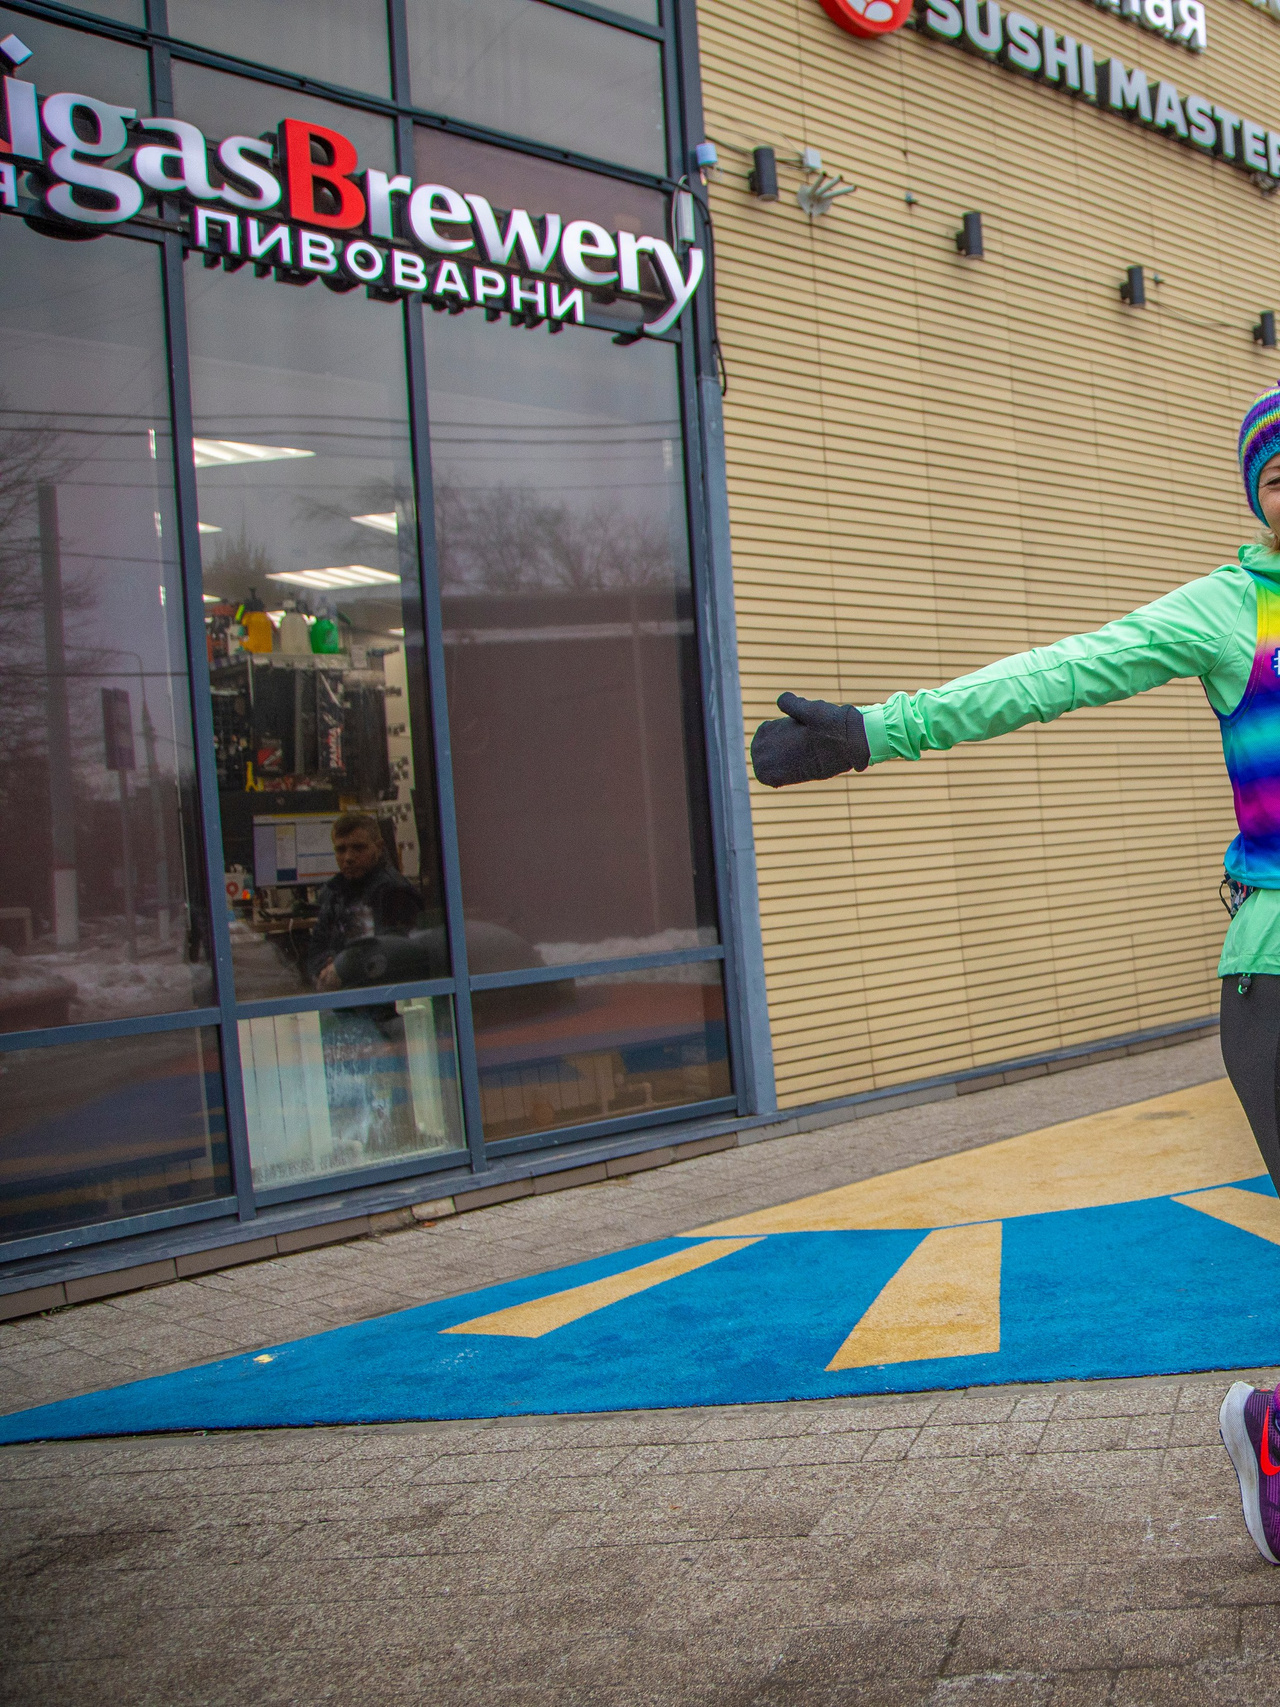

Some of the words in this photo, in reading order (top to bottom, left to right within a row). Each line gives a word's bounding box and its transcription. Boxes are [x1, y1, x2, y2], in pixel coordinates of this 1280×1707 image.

[926, 0, 1096, 96] SUSHI
[0, 33, 703, 335] igasBrewery
[195, 206, 585, 324] ПИВОВАРНИ
